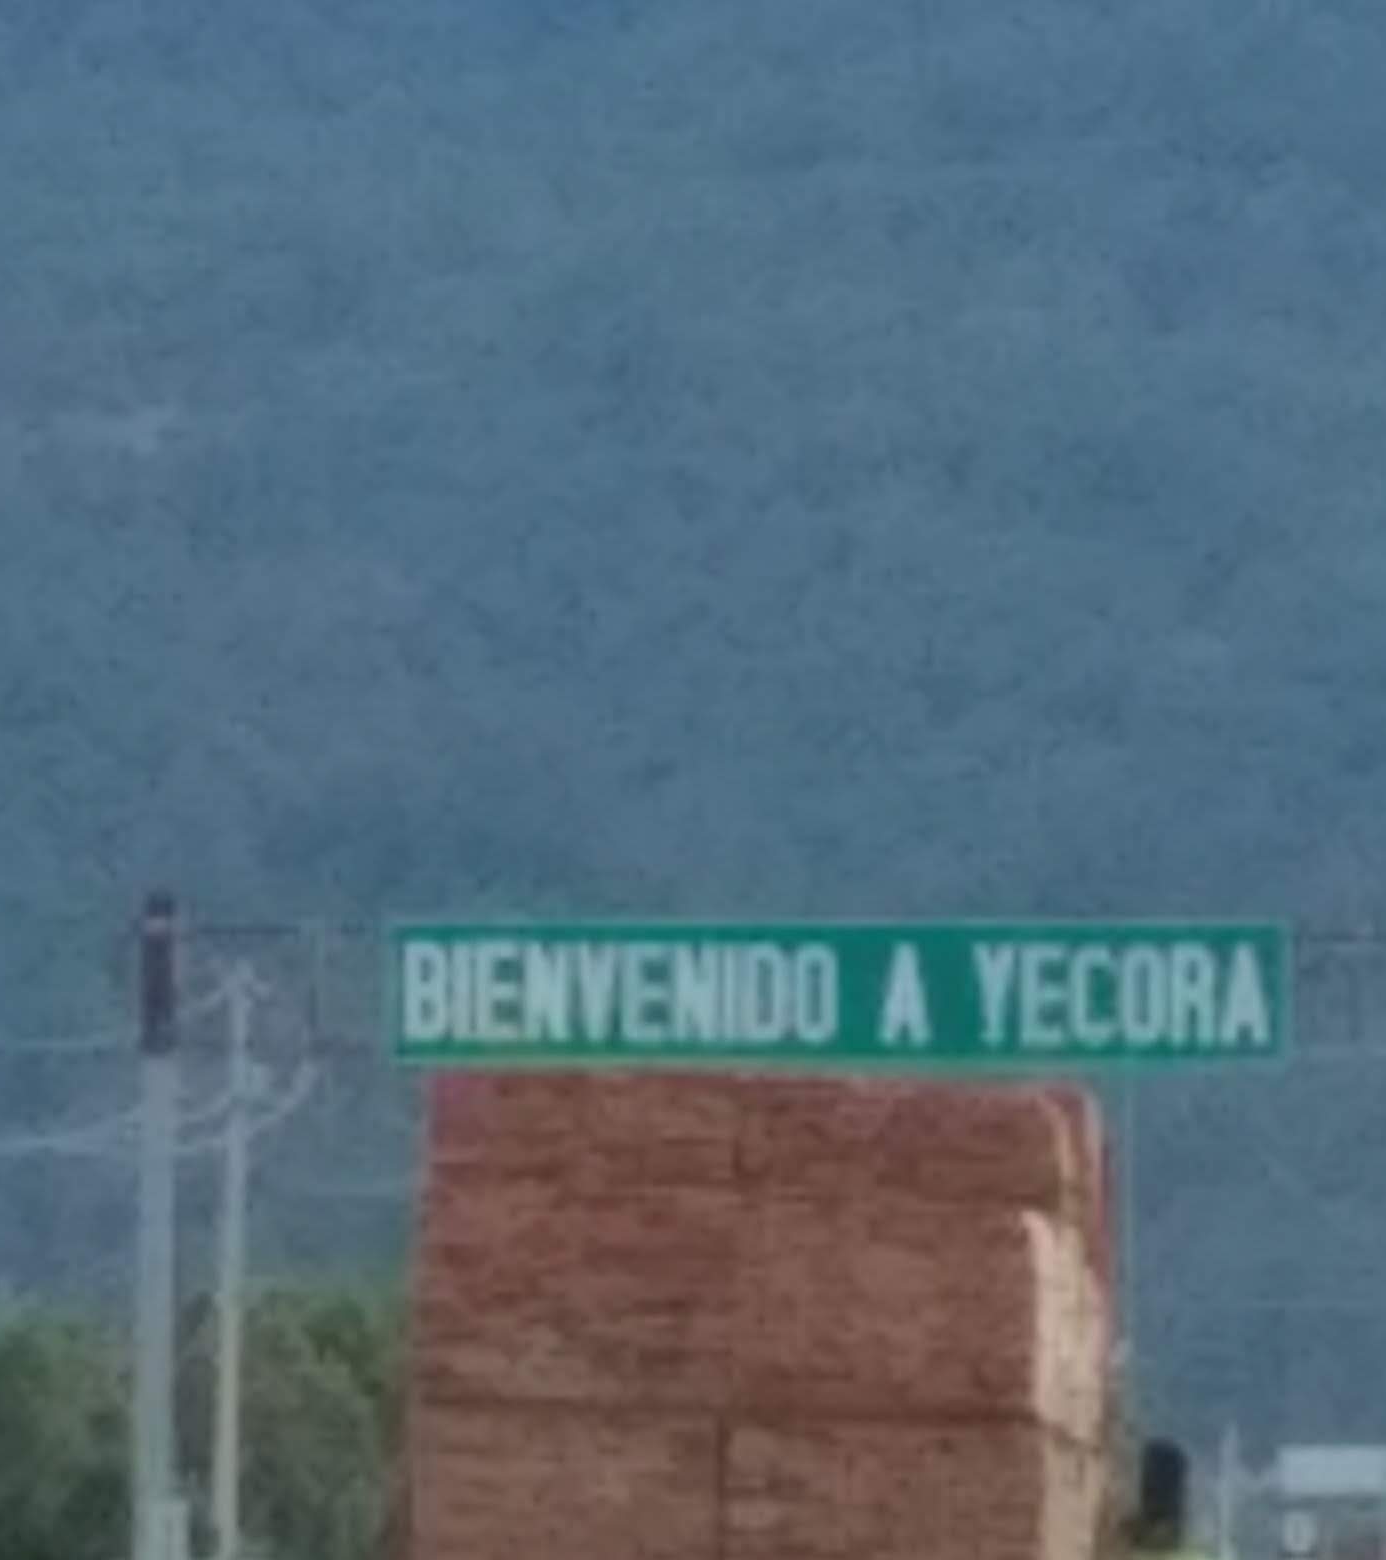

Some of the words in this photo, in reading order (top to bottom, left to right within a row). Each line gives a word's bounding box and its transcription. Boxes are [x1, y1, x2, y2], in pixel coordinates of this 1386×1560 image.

[403, 941, 840, 1043] BIENVENIDO
[878, 942, 933, 1046] A
[972, 942, 1270, 1046] YECORA
